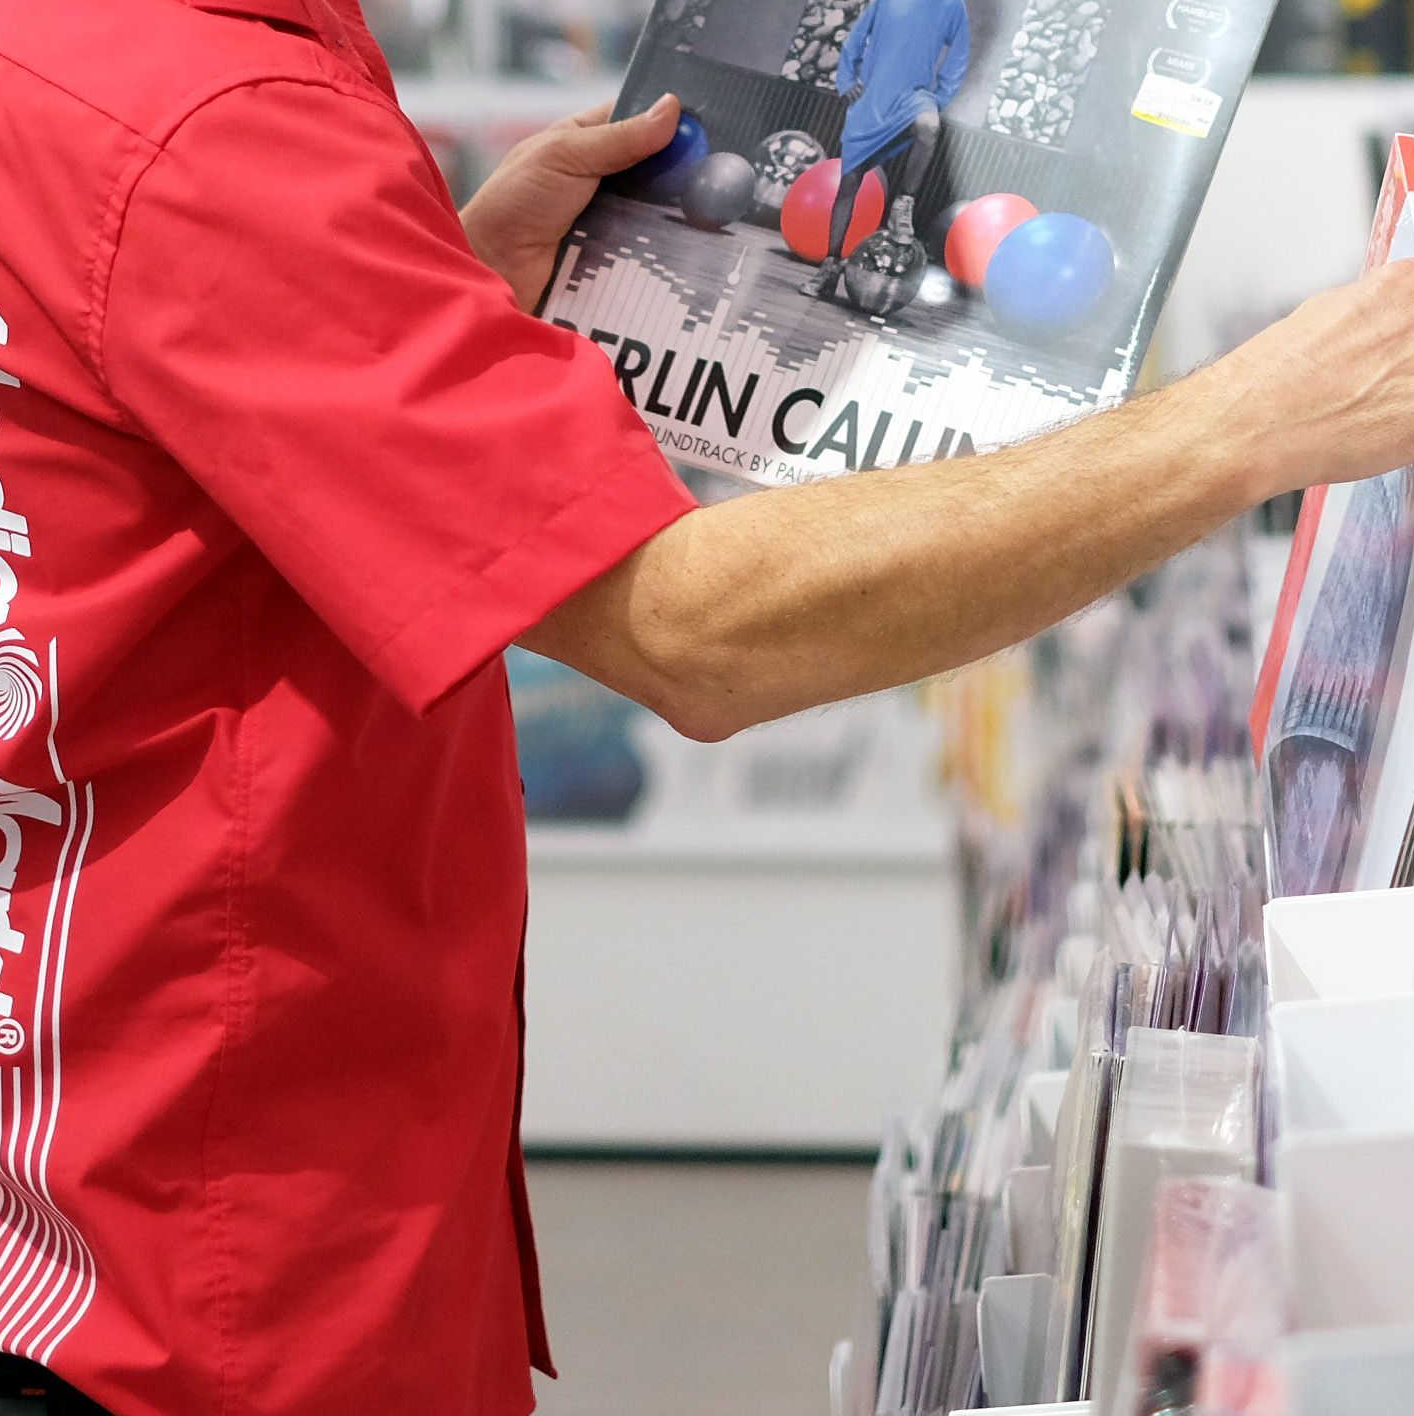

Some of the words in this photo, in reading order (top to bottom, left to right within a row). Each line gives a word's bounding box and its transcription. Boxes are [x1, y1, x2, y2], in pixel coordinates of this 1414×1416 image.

[552, 317, 759, 438] RLIN
[772, 387, 977, 472] CALLI
[647, 423, 748, 467] UNDTRACK
[749, 454, 773, 474] BY
